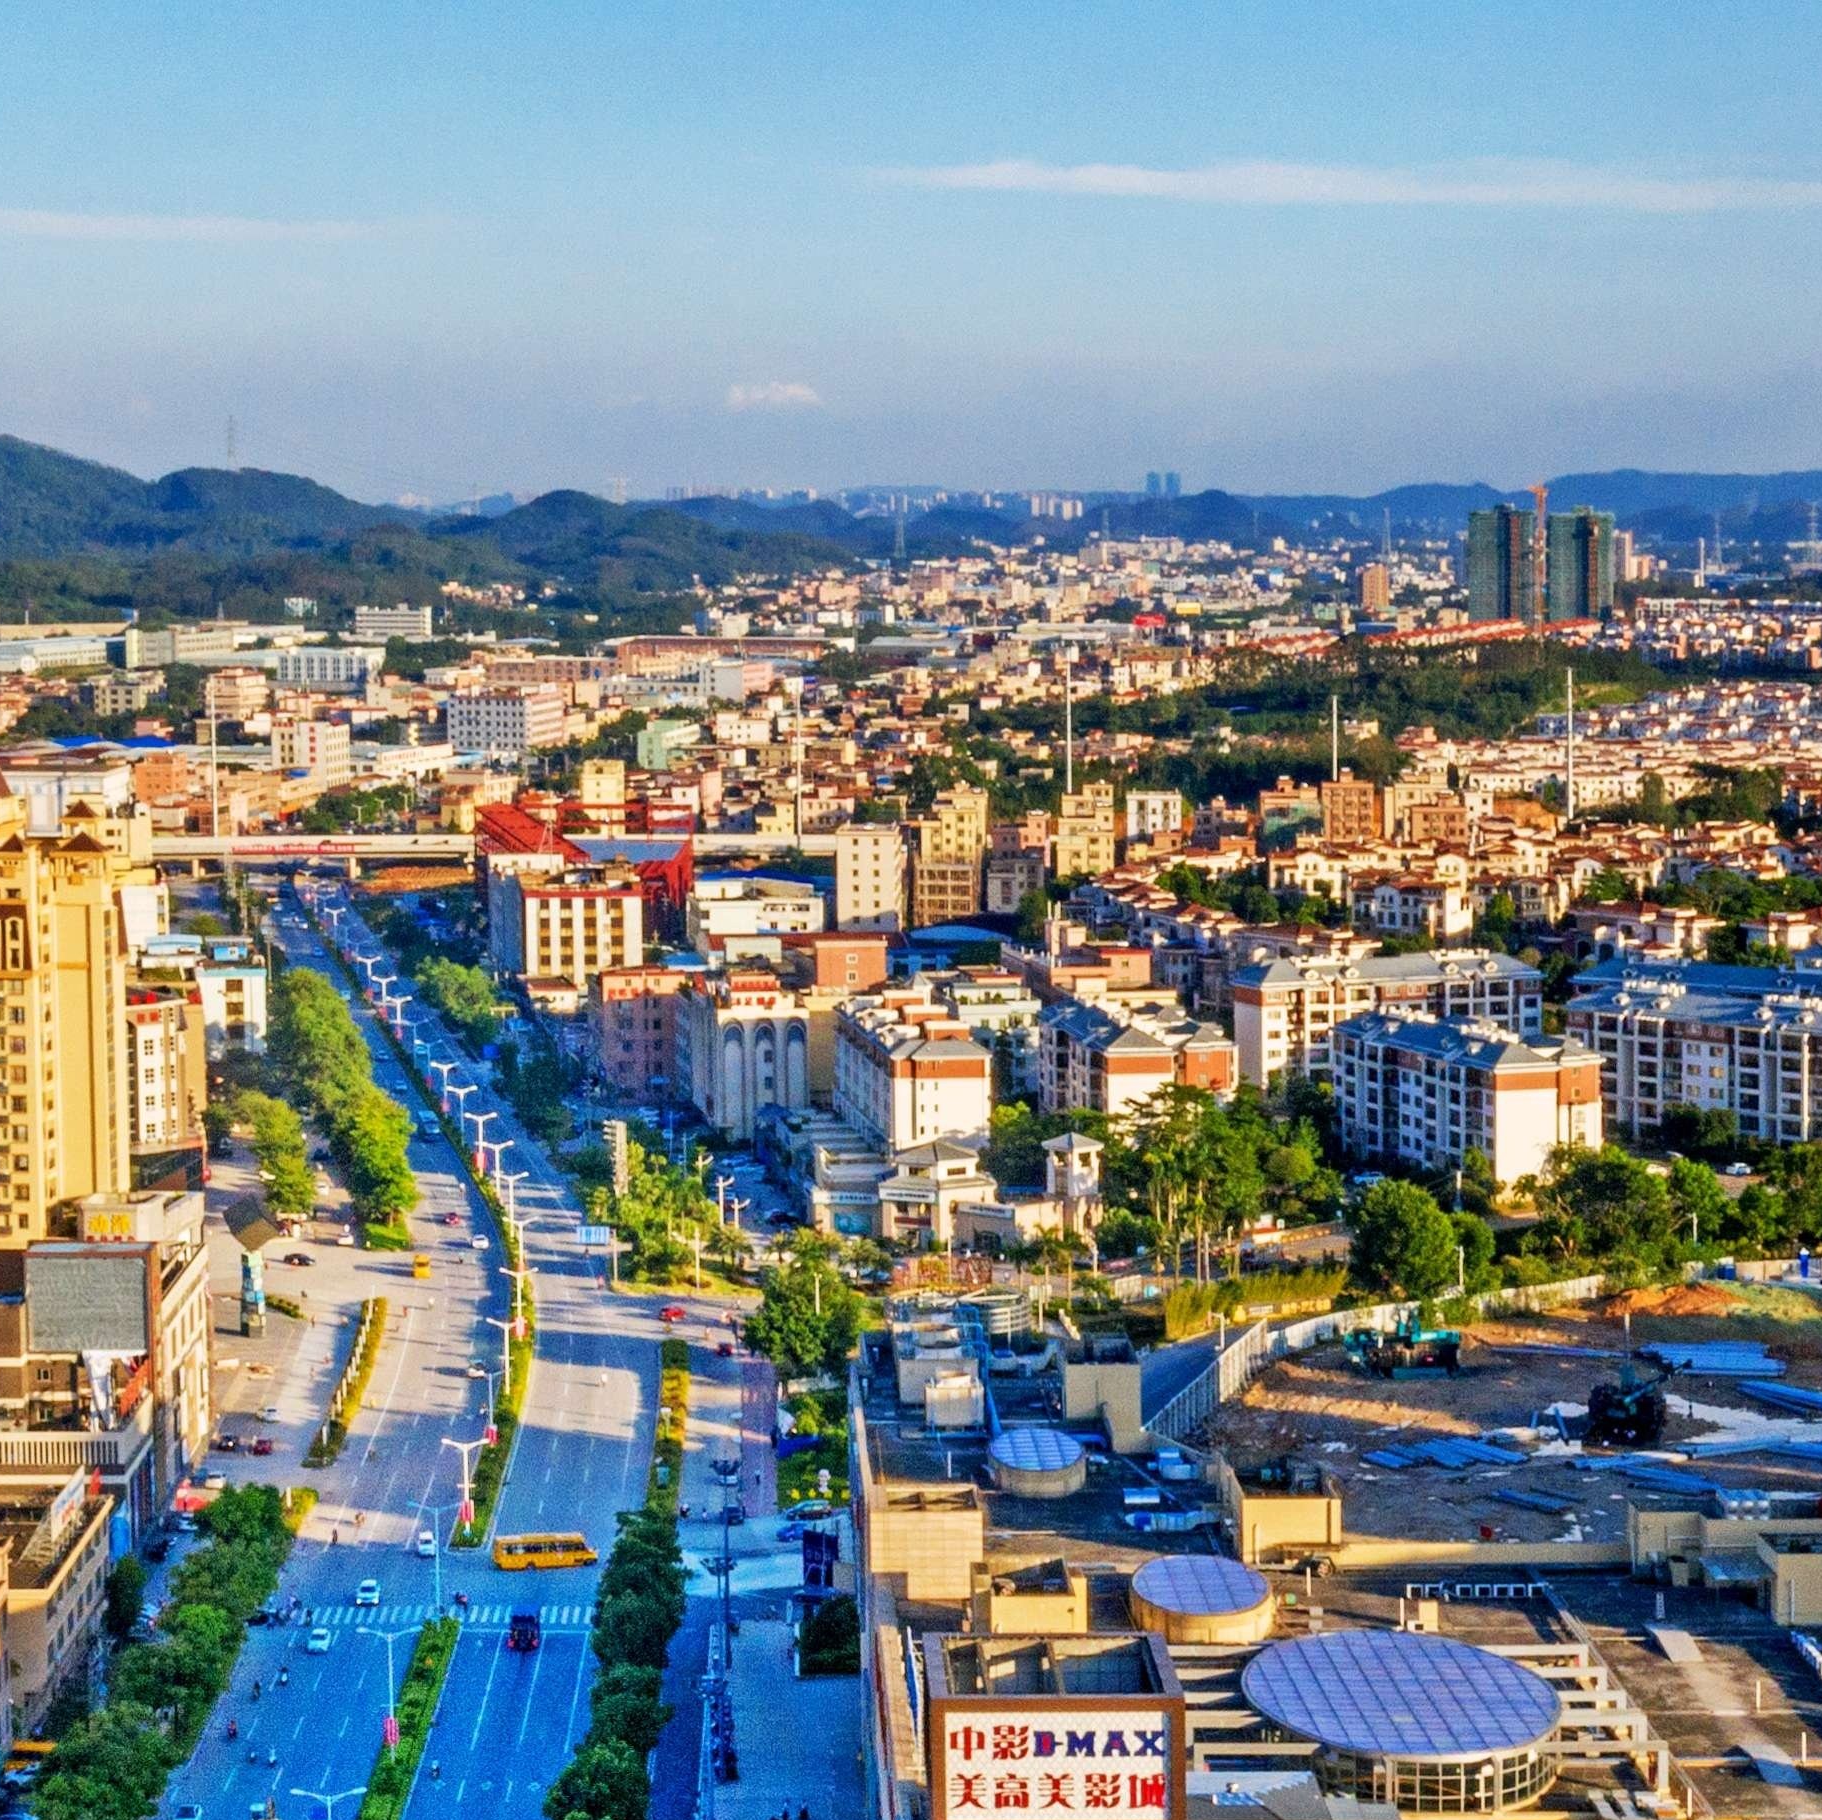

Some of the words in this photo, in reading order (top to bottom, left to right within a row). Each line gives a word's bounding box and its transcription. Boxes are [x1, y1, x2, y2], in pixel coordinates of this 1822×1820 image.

[949, 1773, 1167, 1810] 美高美影城
